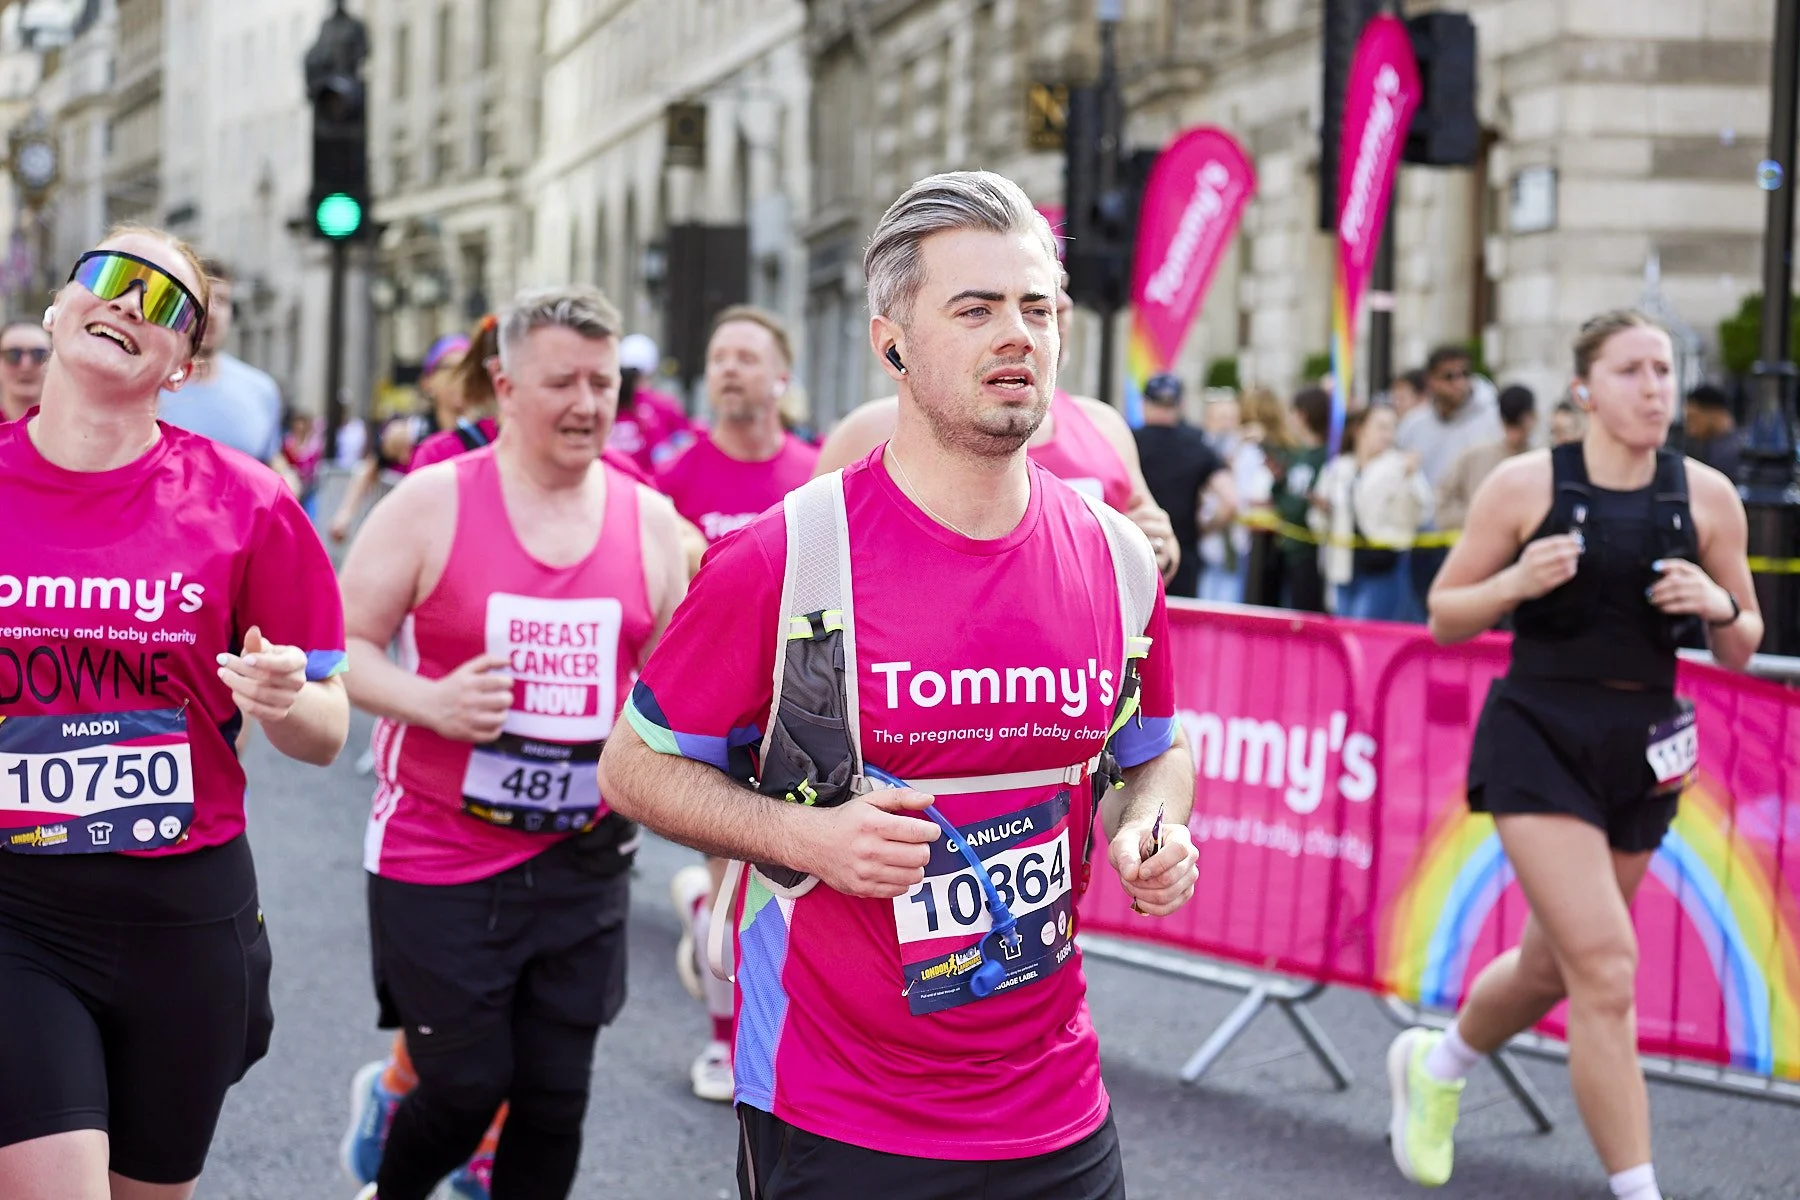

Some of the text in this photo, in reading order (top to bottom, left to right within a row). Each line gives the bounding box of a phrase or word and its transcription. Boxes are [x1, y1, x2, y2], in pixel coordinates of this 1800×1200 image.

[0, 572, 205, 622] ommy's
[0, 625, 196, 645] regnancy and baby charity
[510, 619, 600, 648] BREAST
[510, 649, 599, 679] CANCER
[525, 683, 588, 716] NOW
[871, 658, 1114, 718] Tommy's
[62, 720, 120, 737] MADDI
[873, 729, 903, 744] The
[909, 726, 994, 745] pregnancy
[998, 722, 1029, 738] and
[1033, 723, 1071, 742] baby
[8, 750, 179, 804] 10750
[1176, 708, 1378, 815] mmy's
[501, 766, 573, 802] 481
[946, 816, 1034, 853] GANLUCA
[910, 840, 1065, 933] 10364
[921, 961, 949, 981] LONDON
[1020, 970, 1039, 983] LABEL
